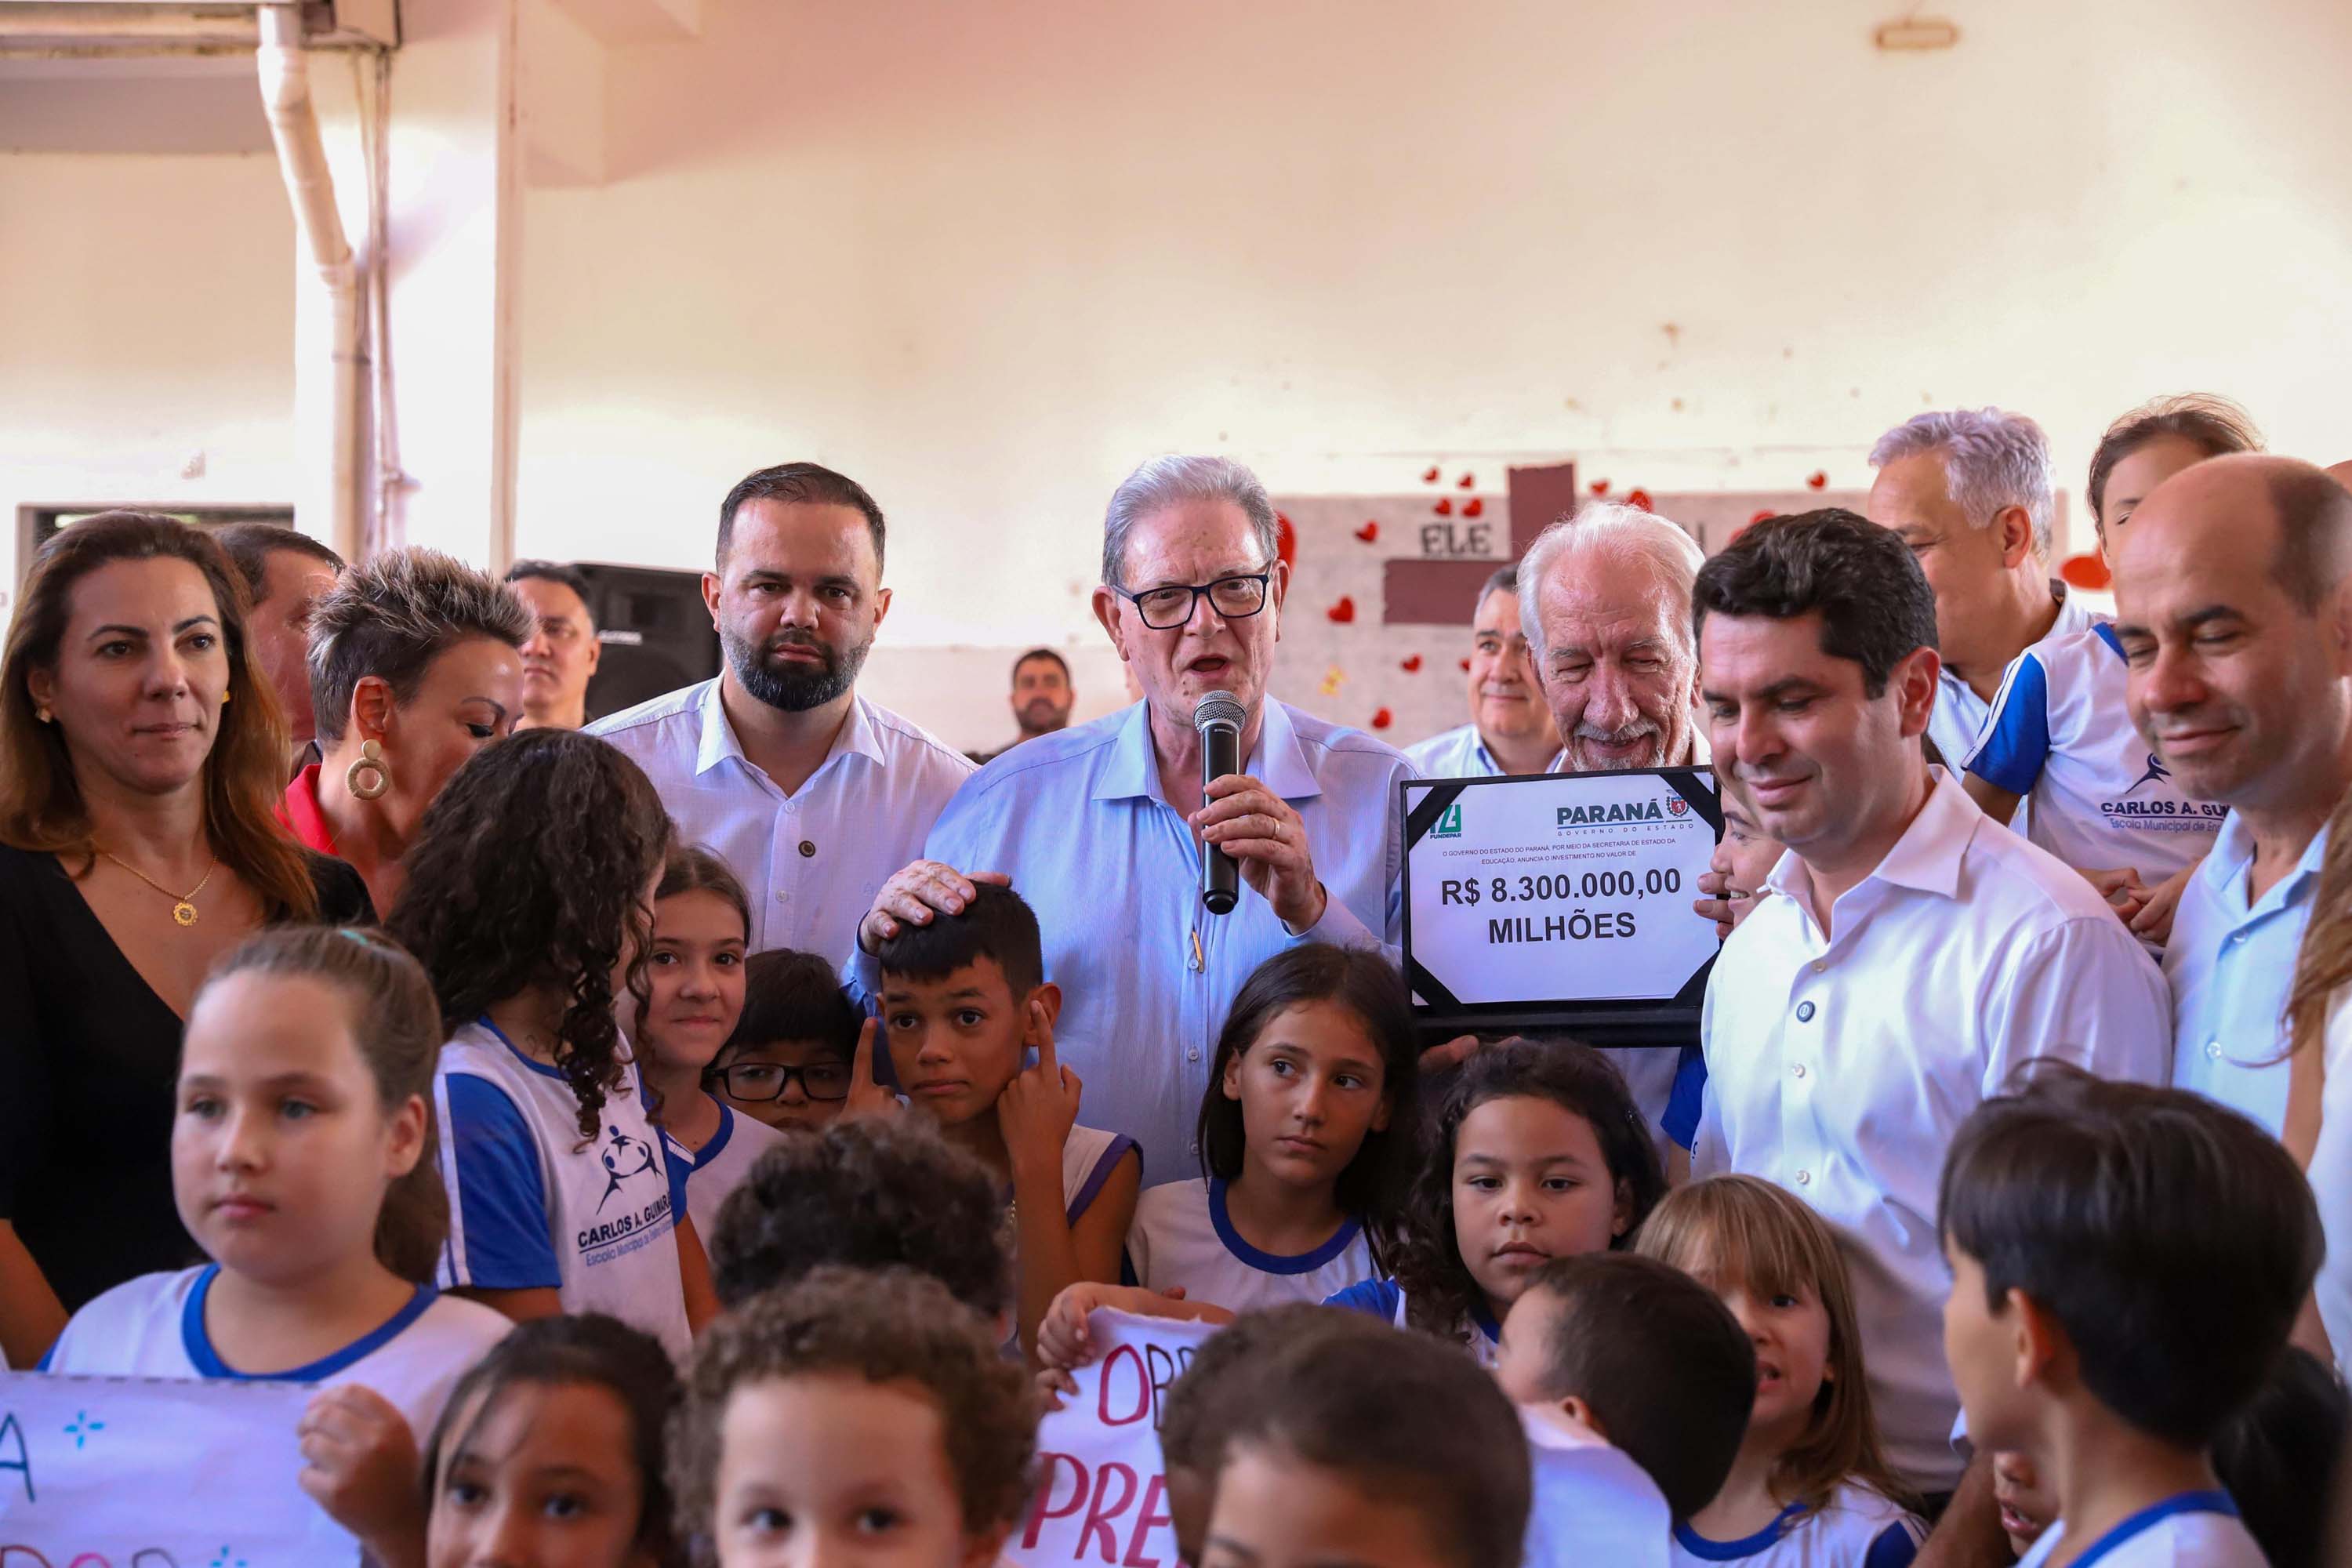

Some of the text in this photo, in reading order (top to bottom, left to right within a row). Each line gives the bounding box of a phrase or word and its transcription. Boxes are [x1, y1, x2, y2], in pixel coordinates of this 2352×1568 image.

[1557, 798, 1663, 825] PARANÁ
[2100, 800, 2176, 815] CARLOS
[2181, 801, 2197, 815] A.
[1557, 828, 1613, 837] GOVERNO
[2110, 818, 2141, 829] Escola
[2143, 820, 2190, 833] Municipal
[2192, 820, 2205, 831] de
[1441, 867, 1681, 906] R$ 8.300.000,00
[1489, 908, 1636, 944] MILHÕES
[578, 1215, 632, 1248] CARLOS
